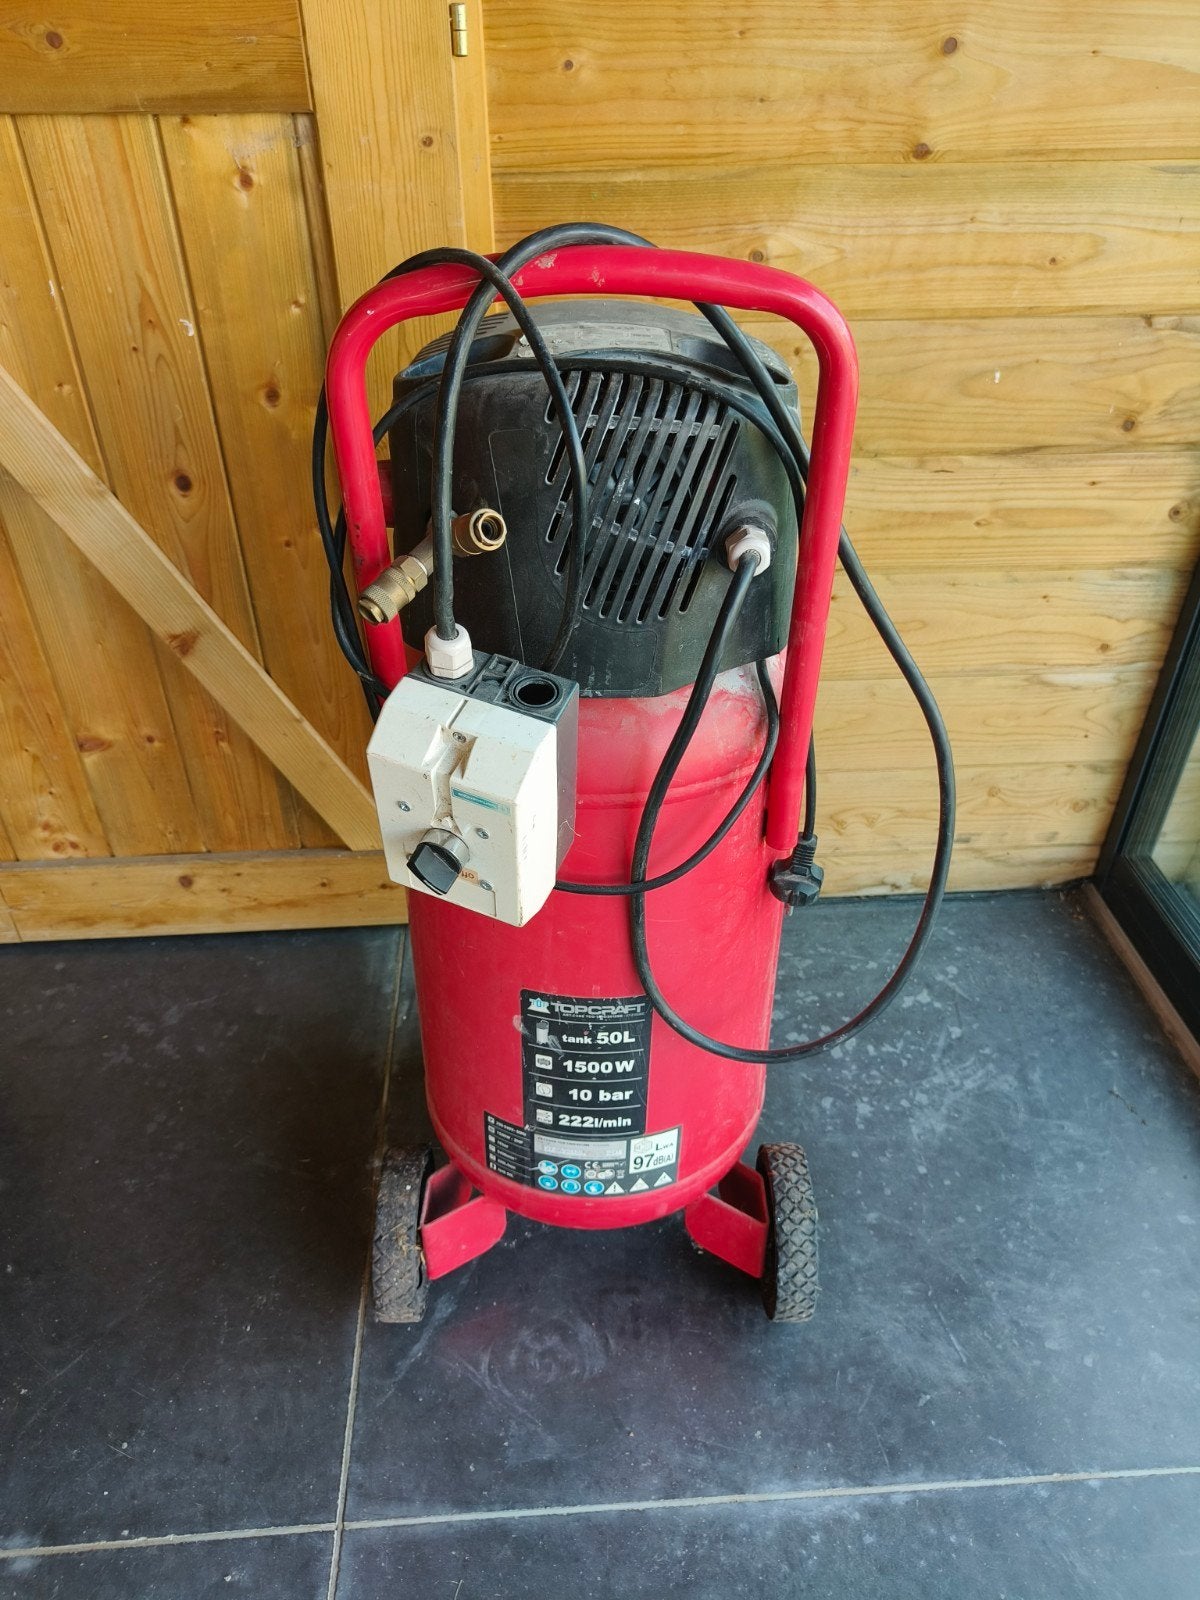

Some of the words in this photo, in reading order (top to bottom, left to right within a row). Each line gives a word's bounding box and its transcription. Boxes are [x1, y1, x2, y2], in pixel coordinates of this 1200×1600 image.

[550, 1001, 646, 1015] TOPCRAFT
[561, 1033, 592, 1044] tank
[596, 1030, 636, 1044] 50L
[568, 1088, 592, 1101] 10
[598, 1089, 634, 1102] bar
[558, 1114, 632, 1128] 222l/min
[633, 1153, 655, 1170] 97
